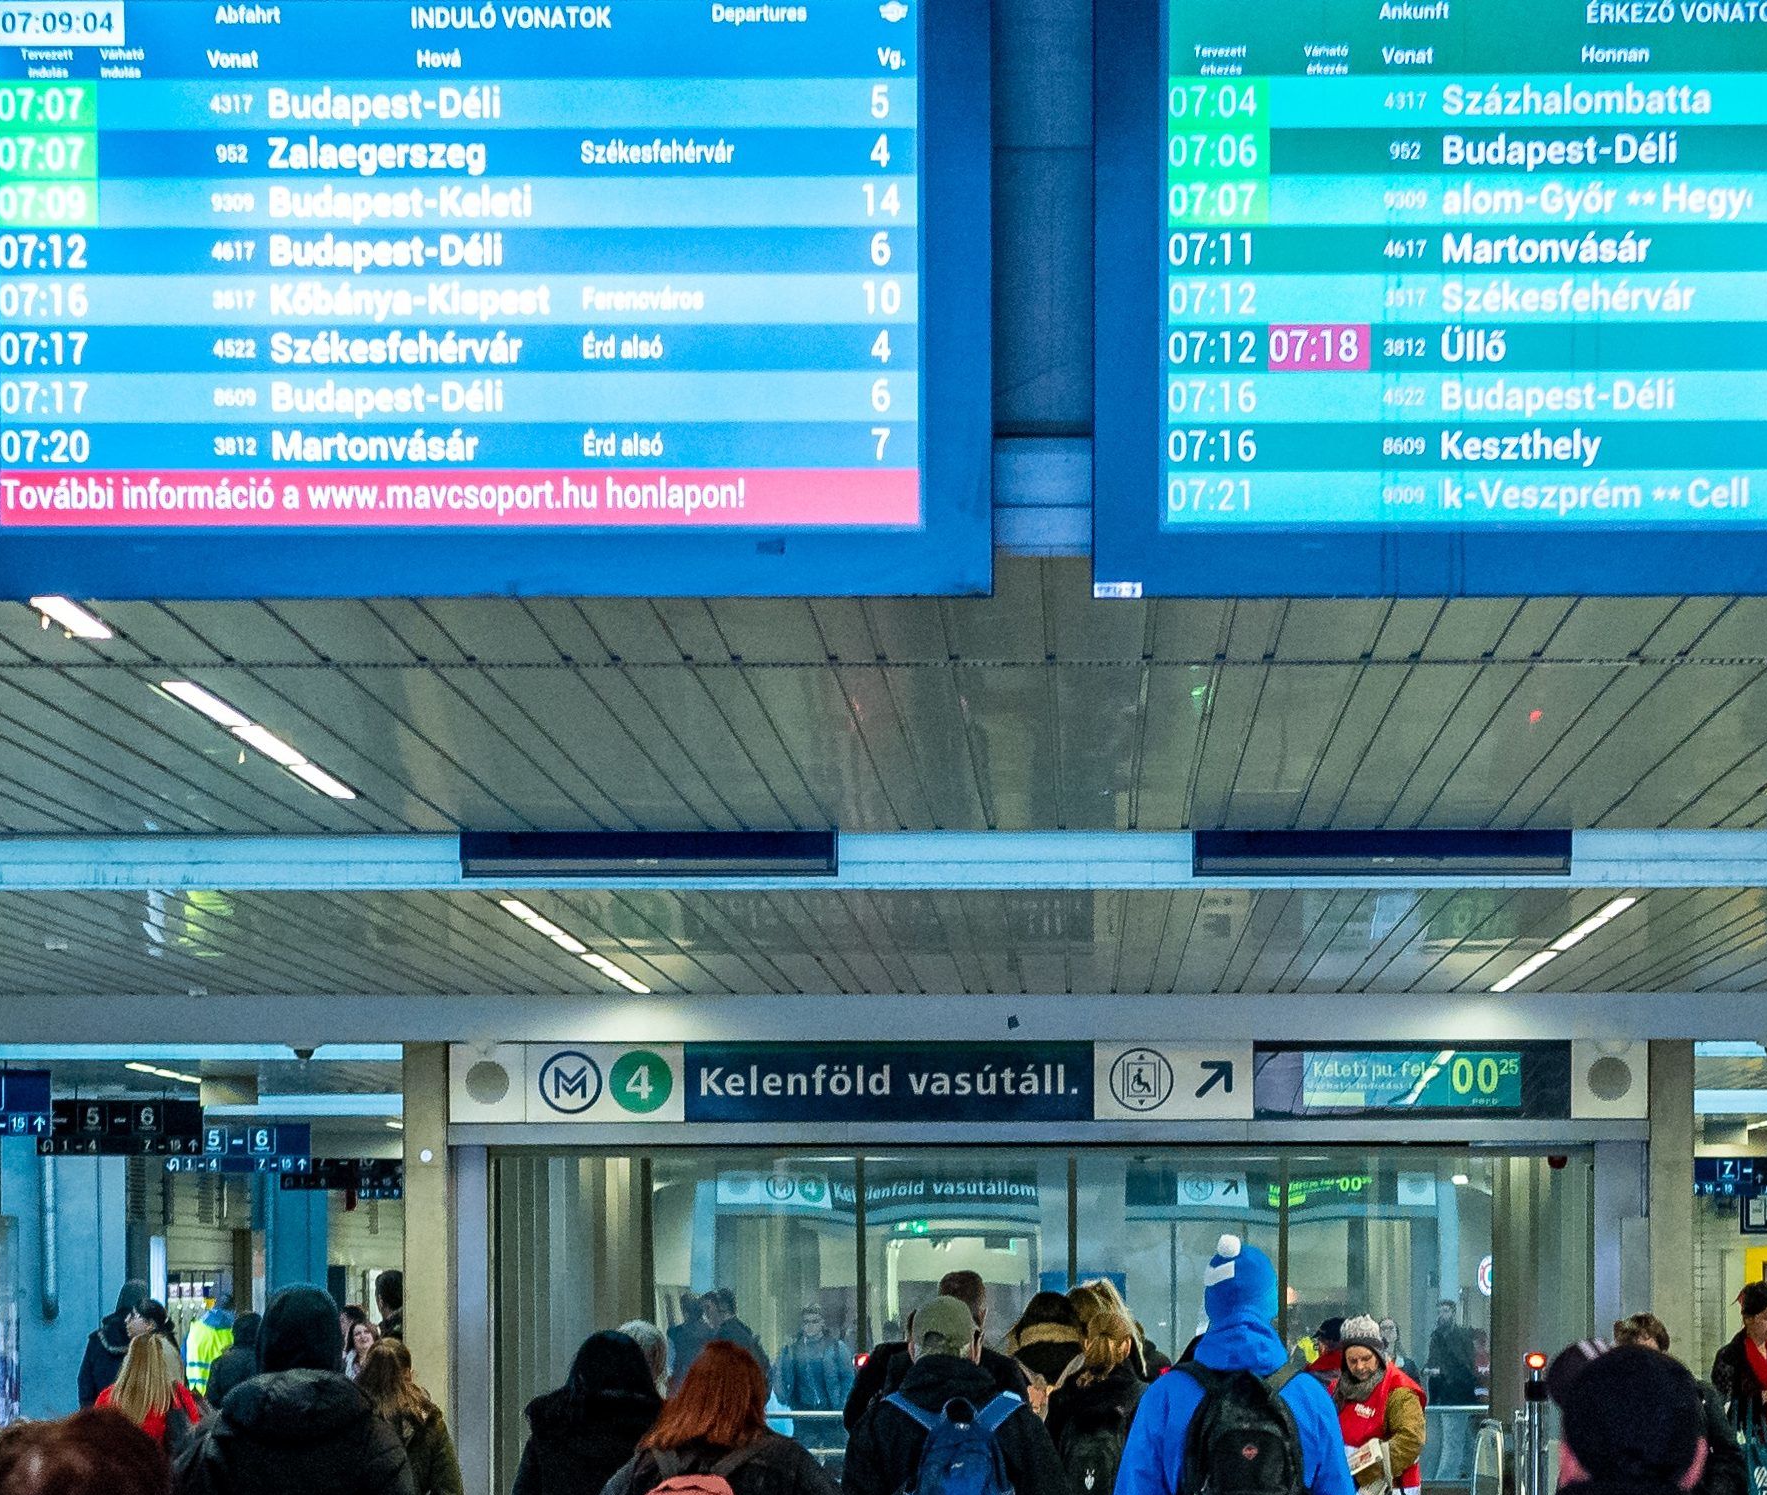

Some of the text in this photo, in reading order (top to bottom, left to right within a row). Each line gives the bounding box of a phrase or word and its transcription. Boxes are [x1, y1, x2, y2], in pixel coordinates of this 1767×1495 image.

[0, 12, 114, 35] 07:09:04
[215, 1, 807, 29] Abfahrt INDULÓ VONATOK Departures
[1379, 1, 1449, 20] Ankunft
[1586, 0, 1674, 25] ÉRKEZŐ
[207, 46, 906, 70] Vonat Hová Vg.
[1382, 46, 1434, 65] Vonat
[1581, 45, 1650, 63] Honnan
[268, 86, 501, 126] Budapest-Déli
[870, 84, 890, 119] 5
[1169, 85, 1257, 117] 07:04
[1442, 83, 1712, 116] Százhalombatta
[268, 135, 486, 176] Zalaegerszeg
[580, 139, 734, 164] Székesfehérvár
[870, 133, 890, 168] 4
[1169, 134, 1257, 167] 07:06
[1442, 131, 1677, 172] Budapest-Déli
[268, 184, 532, 225] Budapest-Keleti
[862, 183, 901, 217] 14
[1168, 183, 1257, 217] 07:07
[269, 233, 503, 274] Budapest-Déli
[870, 231, 891, 267] 6
[1168, 232, 1252, 266] 07:11
[1442, 229, 1652, 264] Martonvásár
[0, 283, 88, 317] 07:16
[270, 279, 551, 321] Kőbánya-Kispest
[862, 279, 901, 315] 10
[1168, 282, 1257, 315] 07:12
[1442, 279, 1696, 313] Székesfehérvár
[0, 332, 88, 366] 07:17
[271, 331, 522, 364] Székesfehérvár
[582, 330, 616, 360] Érd
[621, 333, 663, 360] alsó
[871, 329, 891, 363] 4
[1168, 331, 1257, 364] 07:12
[1268, 329, 1359, 363] 07:18
[1441, 326, 1506, 362] Üllő
[0, 381, 89, 415] 07:17
[272, 379, 503, 420] Budapest-Déli
[871, 378, 891, 412] 6
[1168, 380, 1257, 413] 07:16
[1441, 378, 1675, 418] Budapest-Déli
[1, 430, 90, 463] 07:20
[272, 428, 478, 462] Martonvásár
[583, 428, 616, 457] Érd
[621, 431, 663, 458] alsó
[870, 427, 891, 461] 7
[1168, 429, 1257, 462] 07:16
[1441, 428, 1602, 467] Keszthely
[1, 476, 745, 516] További információ a www.mavcsoport.hu honlapon!
[1168, 479, 1251, 512] 07:21
[1688, 477, 1750, 509] Cell
[625, 1065, 654, 1099] 4
[700, 1064, 891, 1096] Kelenföld
[907, 1063, 1080, 1096] vasútáll.
[1401, 1060, 1438, 1078] fel
[1452, 1058, 1498, 1095] 00
[1499, 1058, 1519, 1075] 25
